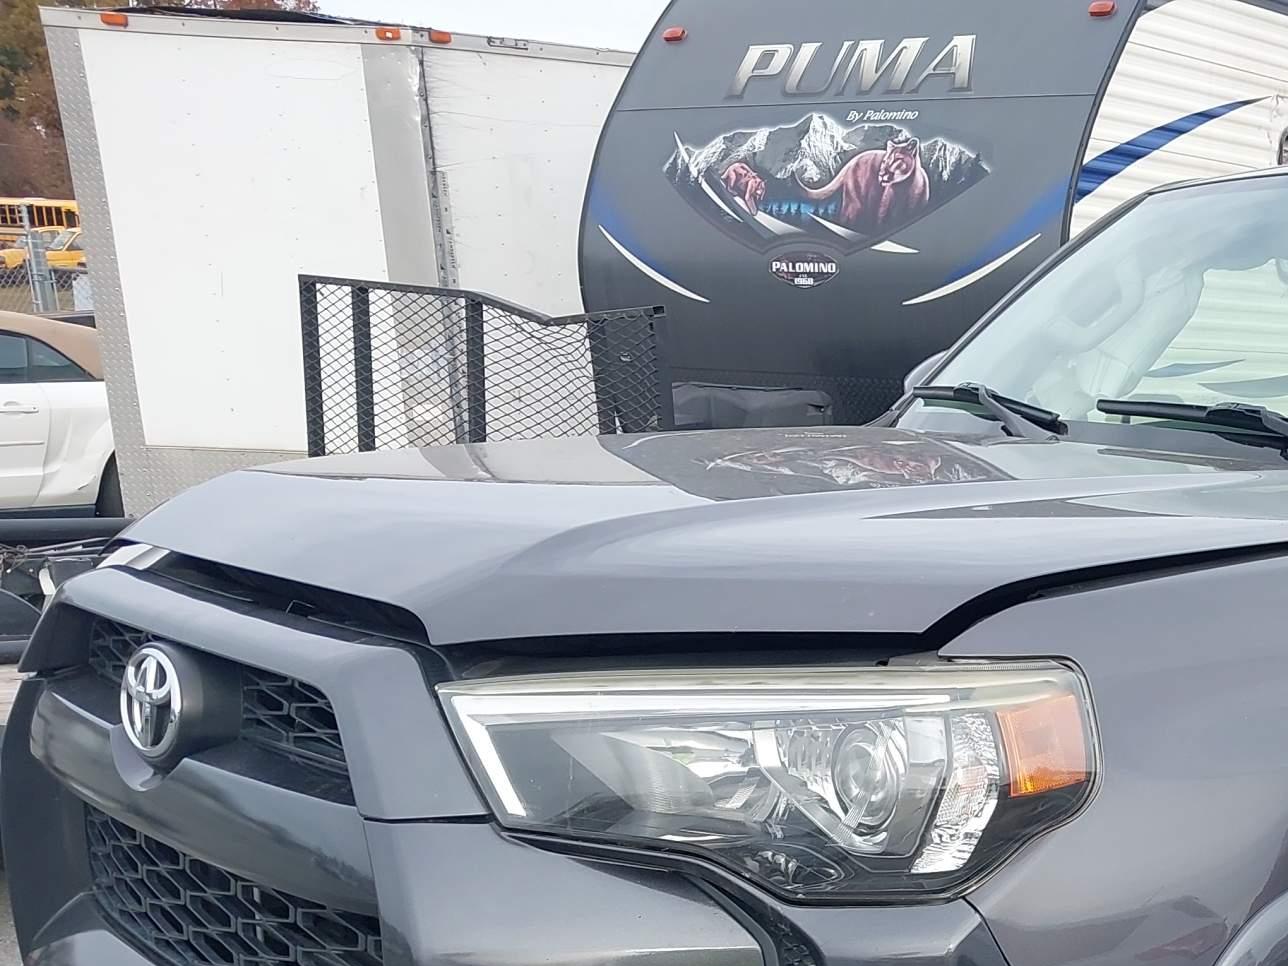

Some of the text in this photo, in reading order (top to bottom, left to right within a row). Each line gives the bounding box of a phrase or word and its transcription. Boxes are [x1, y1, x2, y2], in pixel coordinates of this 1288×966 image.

[722, 34, 977, 100] PUMA
[846, 109, 919, 123] By Palomino
[772, 261, 836, 273] PALOMINO
